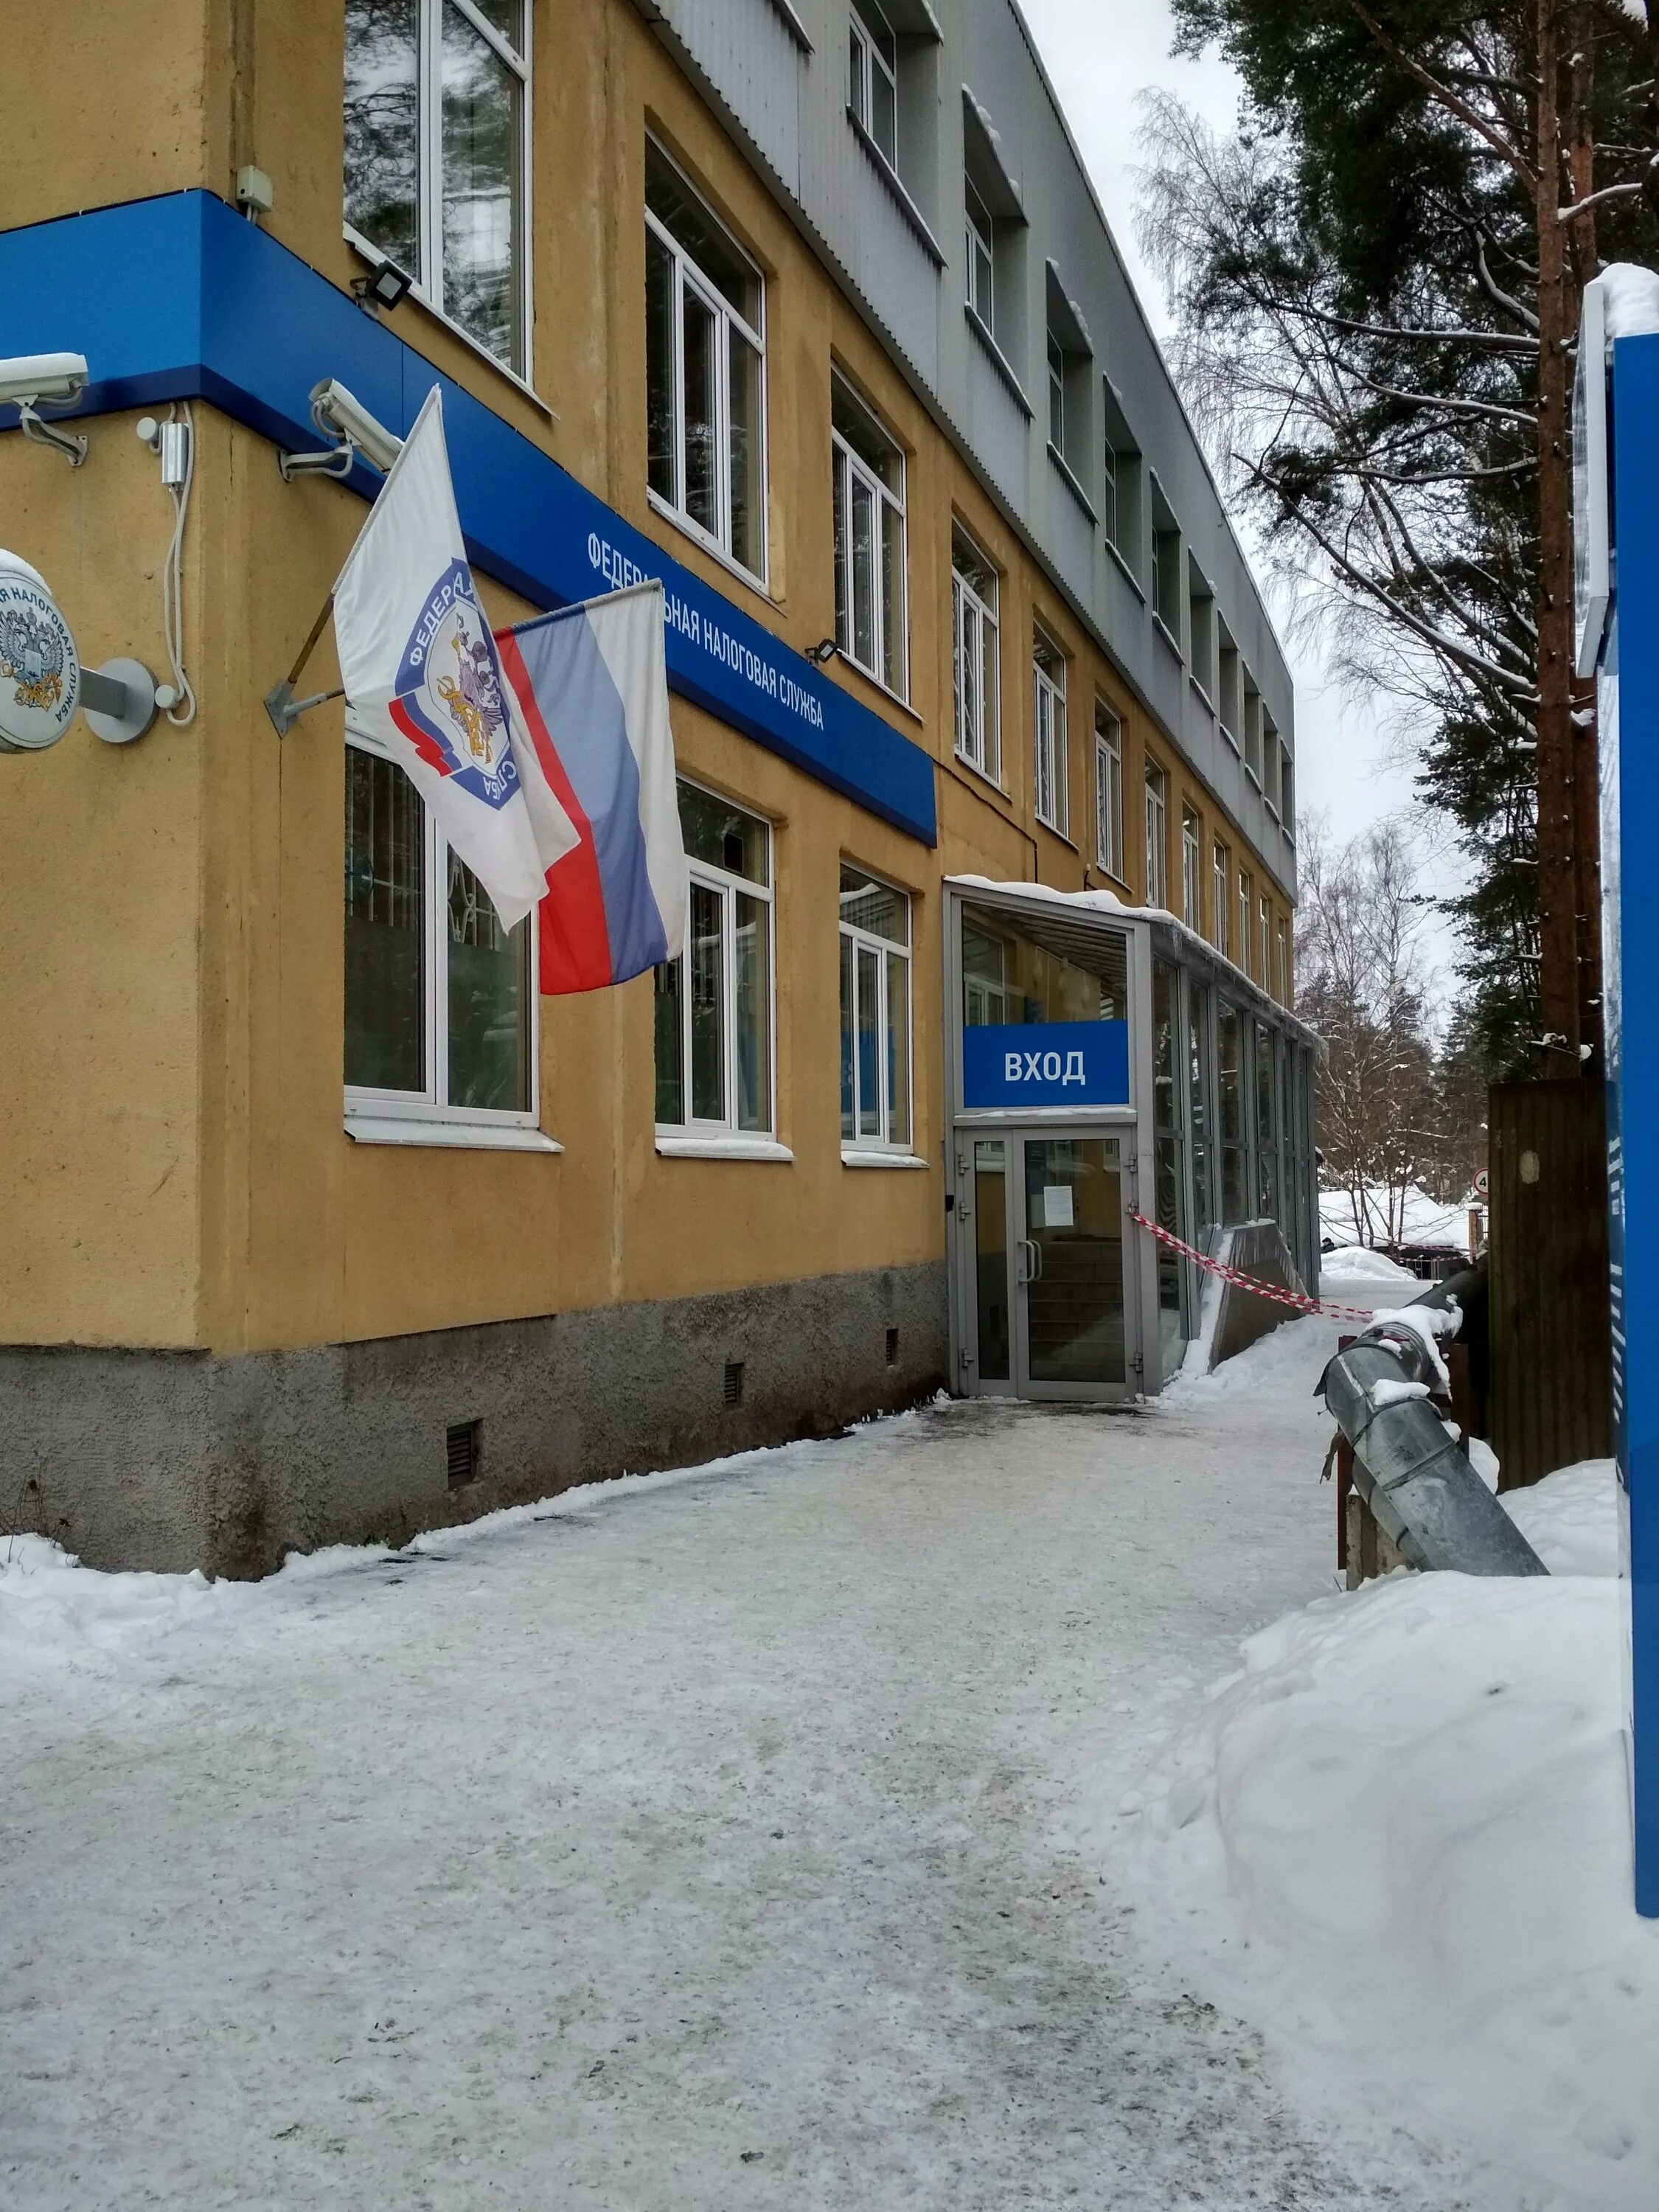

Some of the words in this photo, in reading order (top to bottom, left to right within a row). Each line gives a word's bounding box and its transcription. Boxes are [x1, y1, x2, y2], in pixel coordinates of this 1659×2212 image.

[10, 587, 74, 656] НАЛОГОВАЯ
[55, 662, 76, 723] СЛУЖБА
[588, 532, 700, 644] ФЕДЕРЬНАЯ
[703, 618, 777, 698] НАЛОГОВАЯ
[779, 674, 824, 731] СЛУЖБА
[1005, 1051, 1086, 1086] ВХОД
